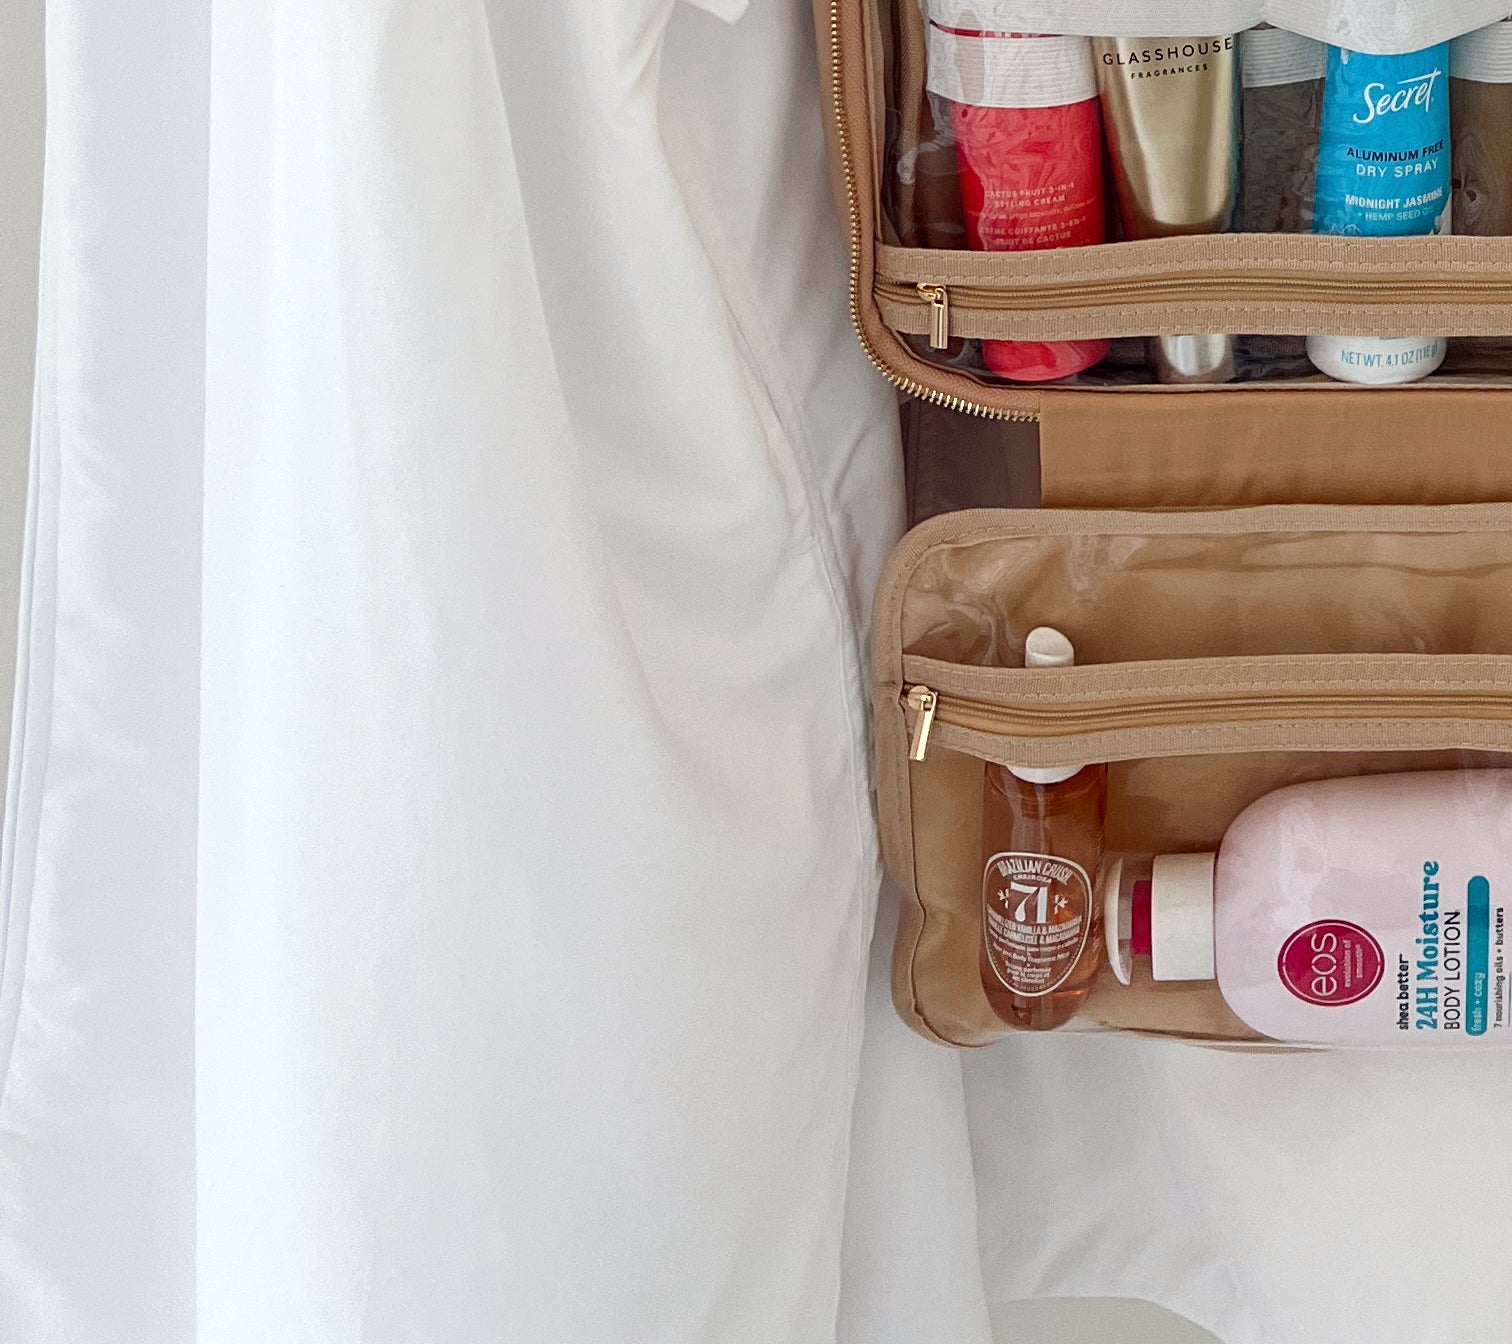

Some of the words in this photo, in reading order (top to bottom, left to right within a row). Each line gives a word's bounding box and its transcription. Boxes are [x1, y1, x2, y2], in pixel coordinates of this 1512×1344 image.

[1102, 37, 1233, 66] GLASSHOUSE
[1131, 64, 1208, 80] FRAGRANCES
[1353, 67, 1442, 124] Secret
[1346, 148, 1419, 162] ALUMINUM
[1422, 139, 1444, 158] FREE
[1356, 163, 1388, 178] DRY
[1394, 158, 1439, 178] SPRAY
[1345, 194, 1400, 209] MIDNIGHT
[1341, 349, 1362, 365] NET
[1401, 351, 1414, 365] OZ
[1010, 881, 1048, 924] 71
[1416, 861, 1440, 981] Moisture
[1494, 907, 1504, 946] butters
[1443, 911, 1461, 981] LOTION
[1311, 932, 1338, 997] eos
[1475, 972, 1486, 997] cozy
[1396, 1002, 1409, 1030] shea
[1416, 987, 1438, 1030] 24H
[1443, 985, 1461, 1030] BODY
[1471, 1006, 1483, 1032] fresh
